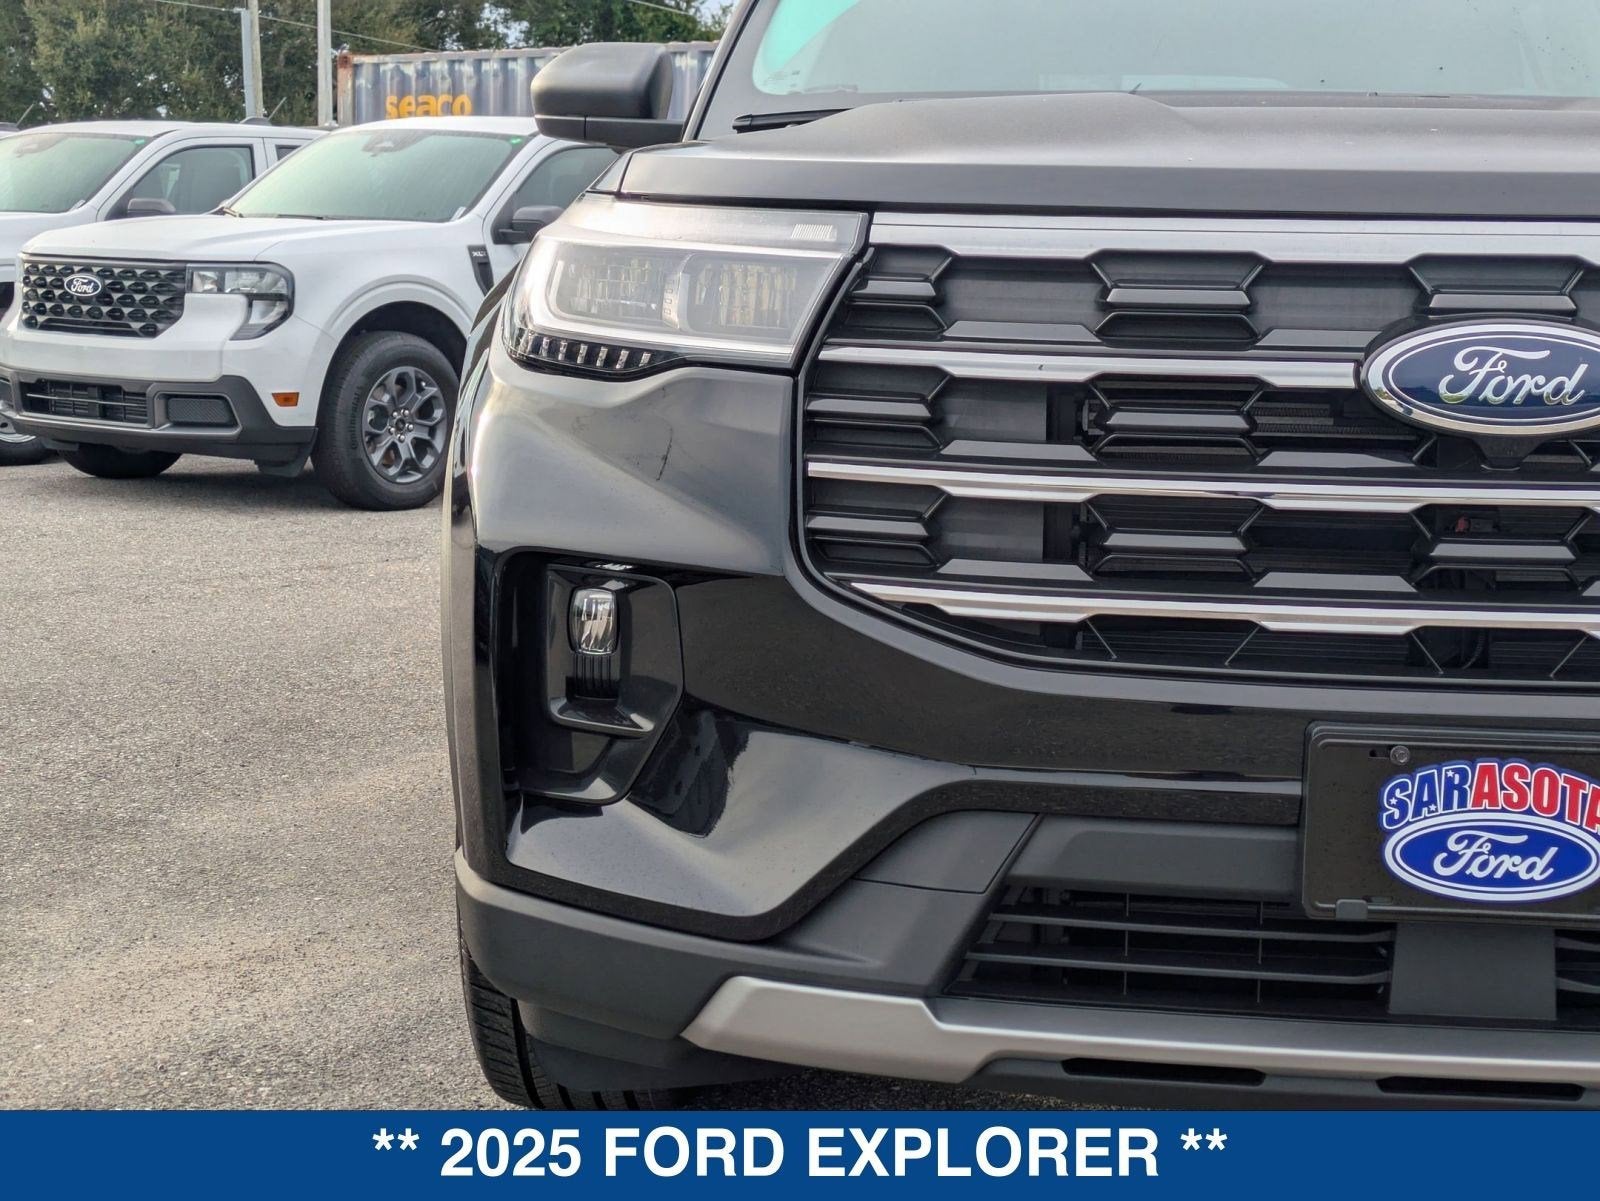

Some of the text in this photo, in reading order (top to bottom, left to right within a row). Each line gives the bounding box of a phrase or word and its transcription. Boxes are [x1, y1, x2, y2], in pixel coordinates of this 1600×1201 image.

[385, 94, 472, 119] seaco
[70, 277, 95, 293] Ford
[1438, 346, 1589, 406] Ford
[1433, 830, 1559, 881] Ford
